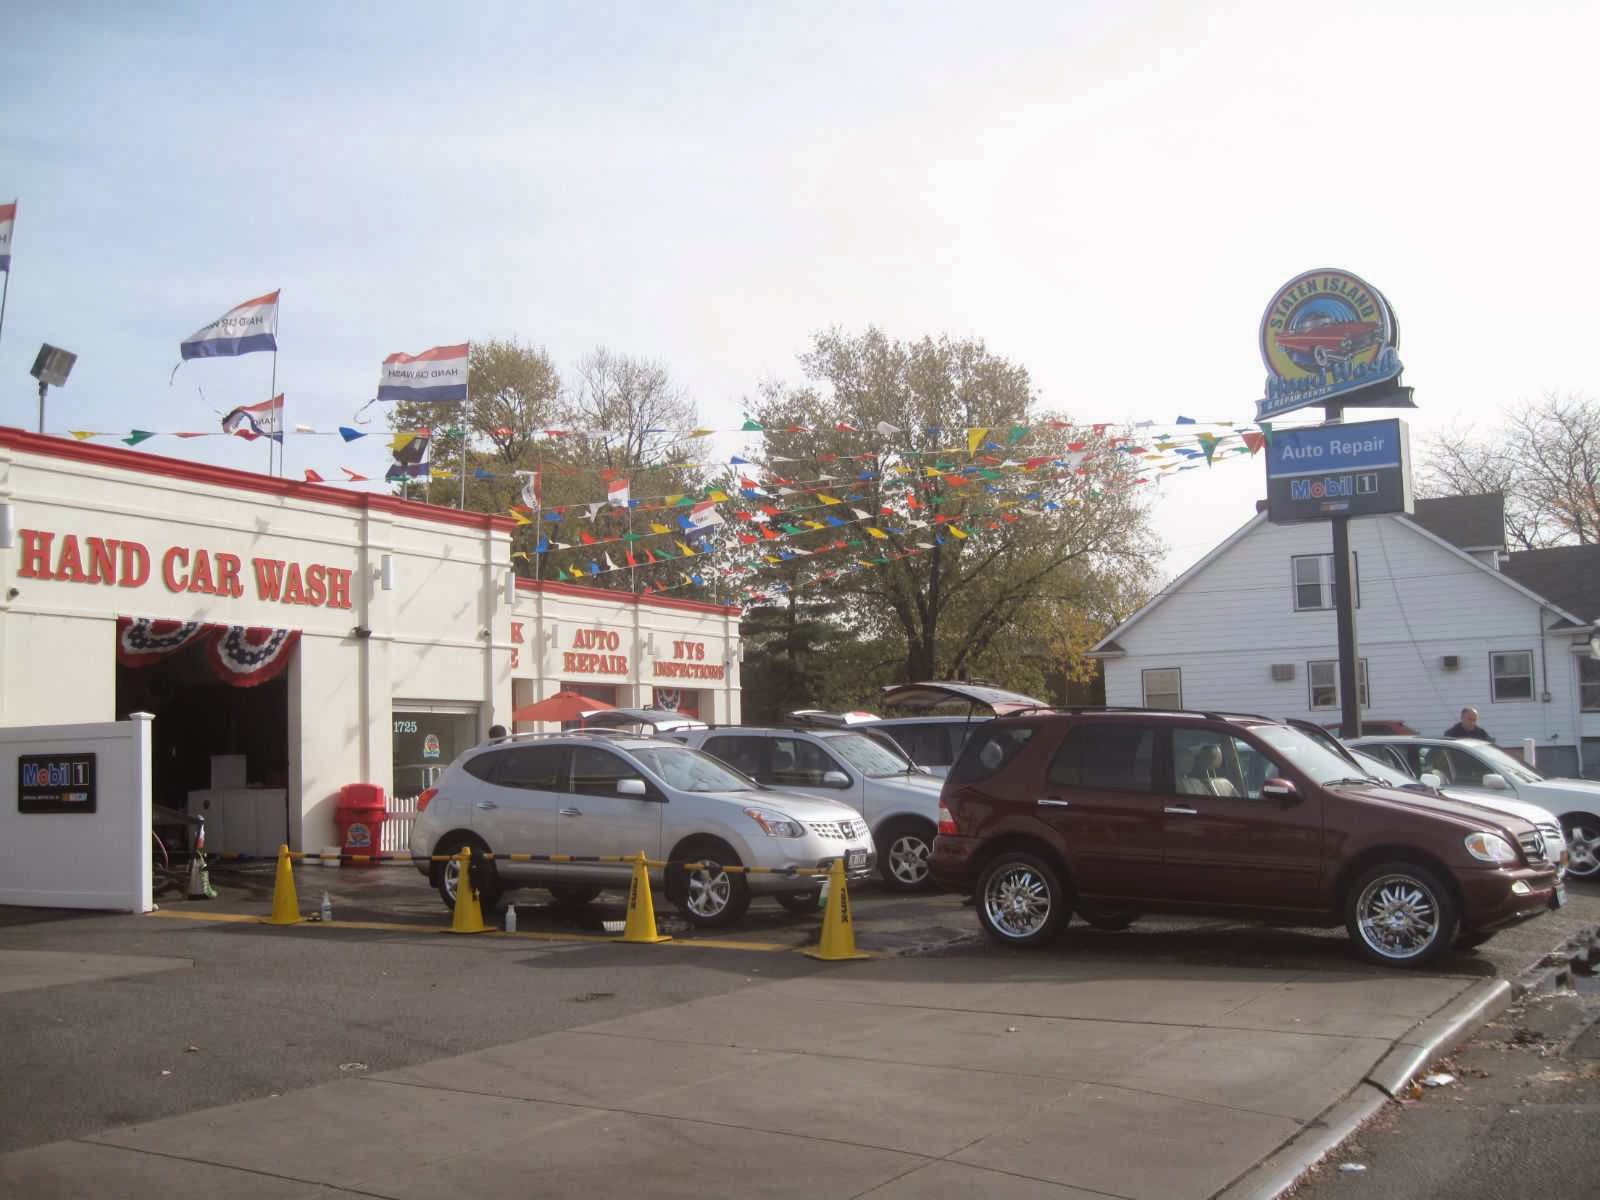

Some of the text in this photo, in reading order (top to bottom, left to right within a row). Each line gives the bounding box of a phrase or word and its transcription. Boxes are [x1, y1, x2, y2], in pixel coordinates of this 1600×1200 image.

[1270, 277, 1375, 329] STATEN ISLAND
[1281, 437, 1385, 461] Auto Repair
[1290, 475, 1353, 500] Mobil
[18, 529, 353, 609] HAND CAR WASH
[573, 629, 620, 651] AUTO
[672, 640, 705, 661] NYS
[562, 651, 629, 675] REPAIR
[653, 661, 725, 681] INSPECTIONS
[393, 719, 418, 734] 1725
[23, 762, 70, 787] Mobil
